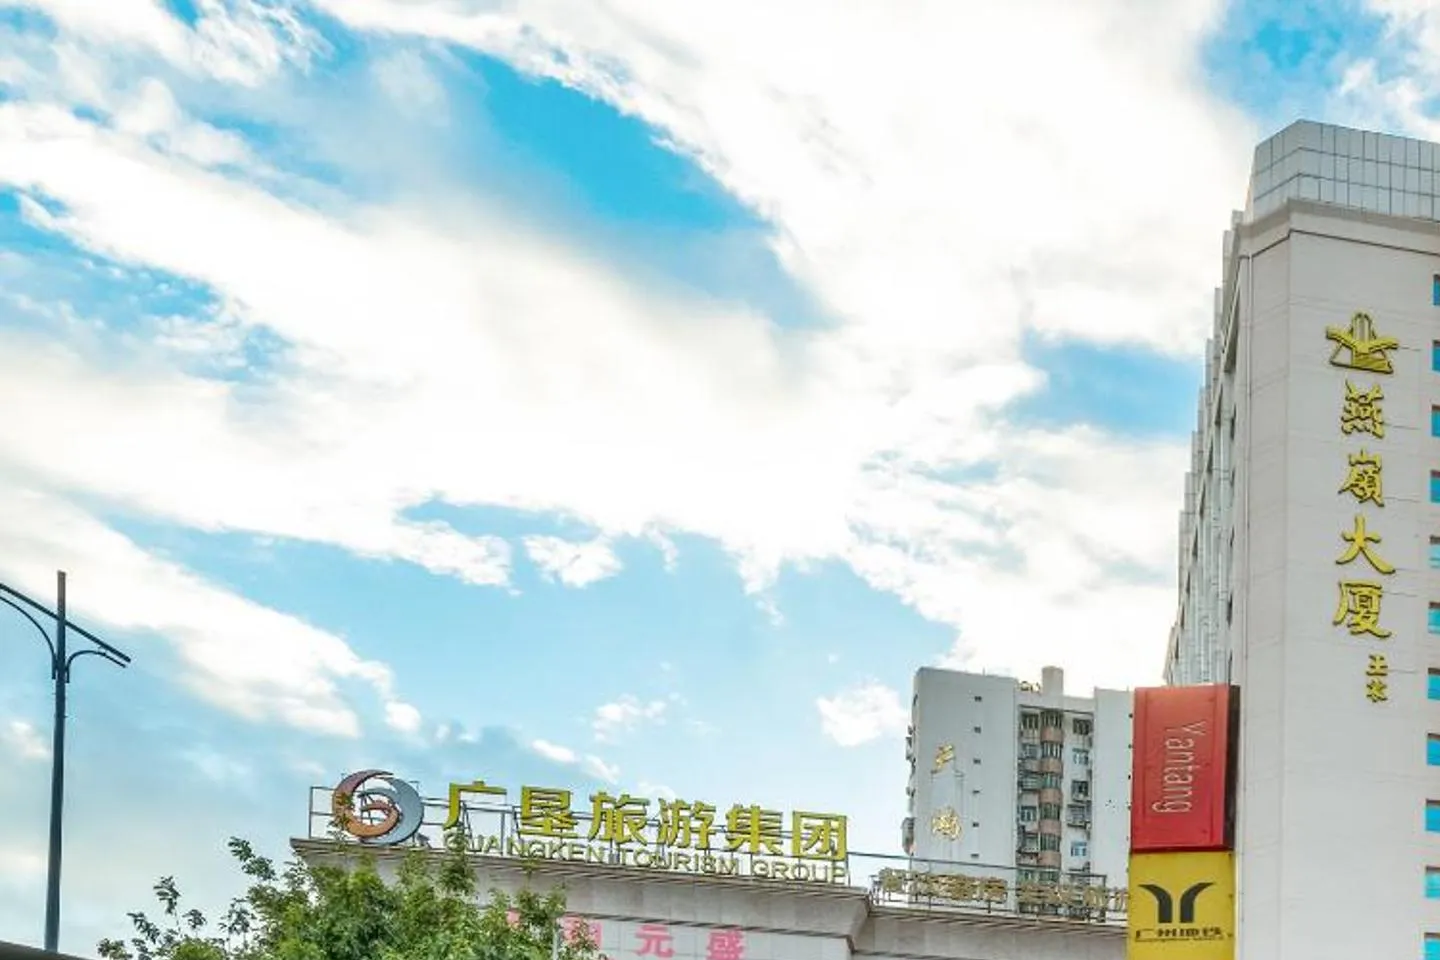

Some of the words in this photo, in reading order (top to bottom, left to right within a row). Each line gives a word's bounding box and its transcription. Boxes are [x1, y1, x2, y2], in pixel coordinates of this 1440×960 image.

[1151, 720, 1207, 813] Yantang
[442, 780, 848, 862] 广垦旅游集团
[615, 846, 739, 877] TOURISM
[752, 862, 849, 886] GROUP
